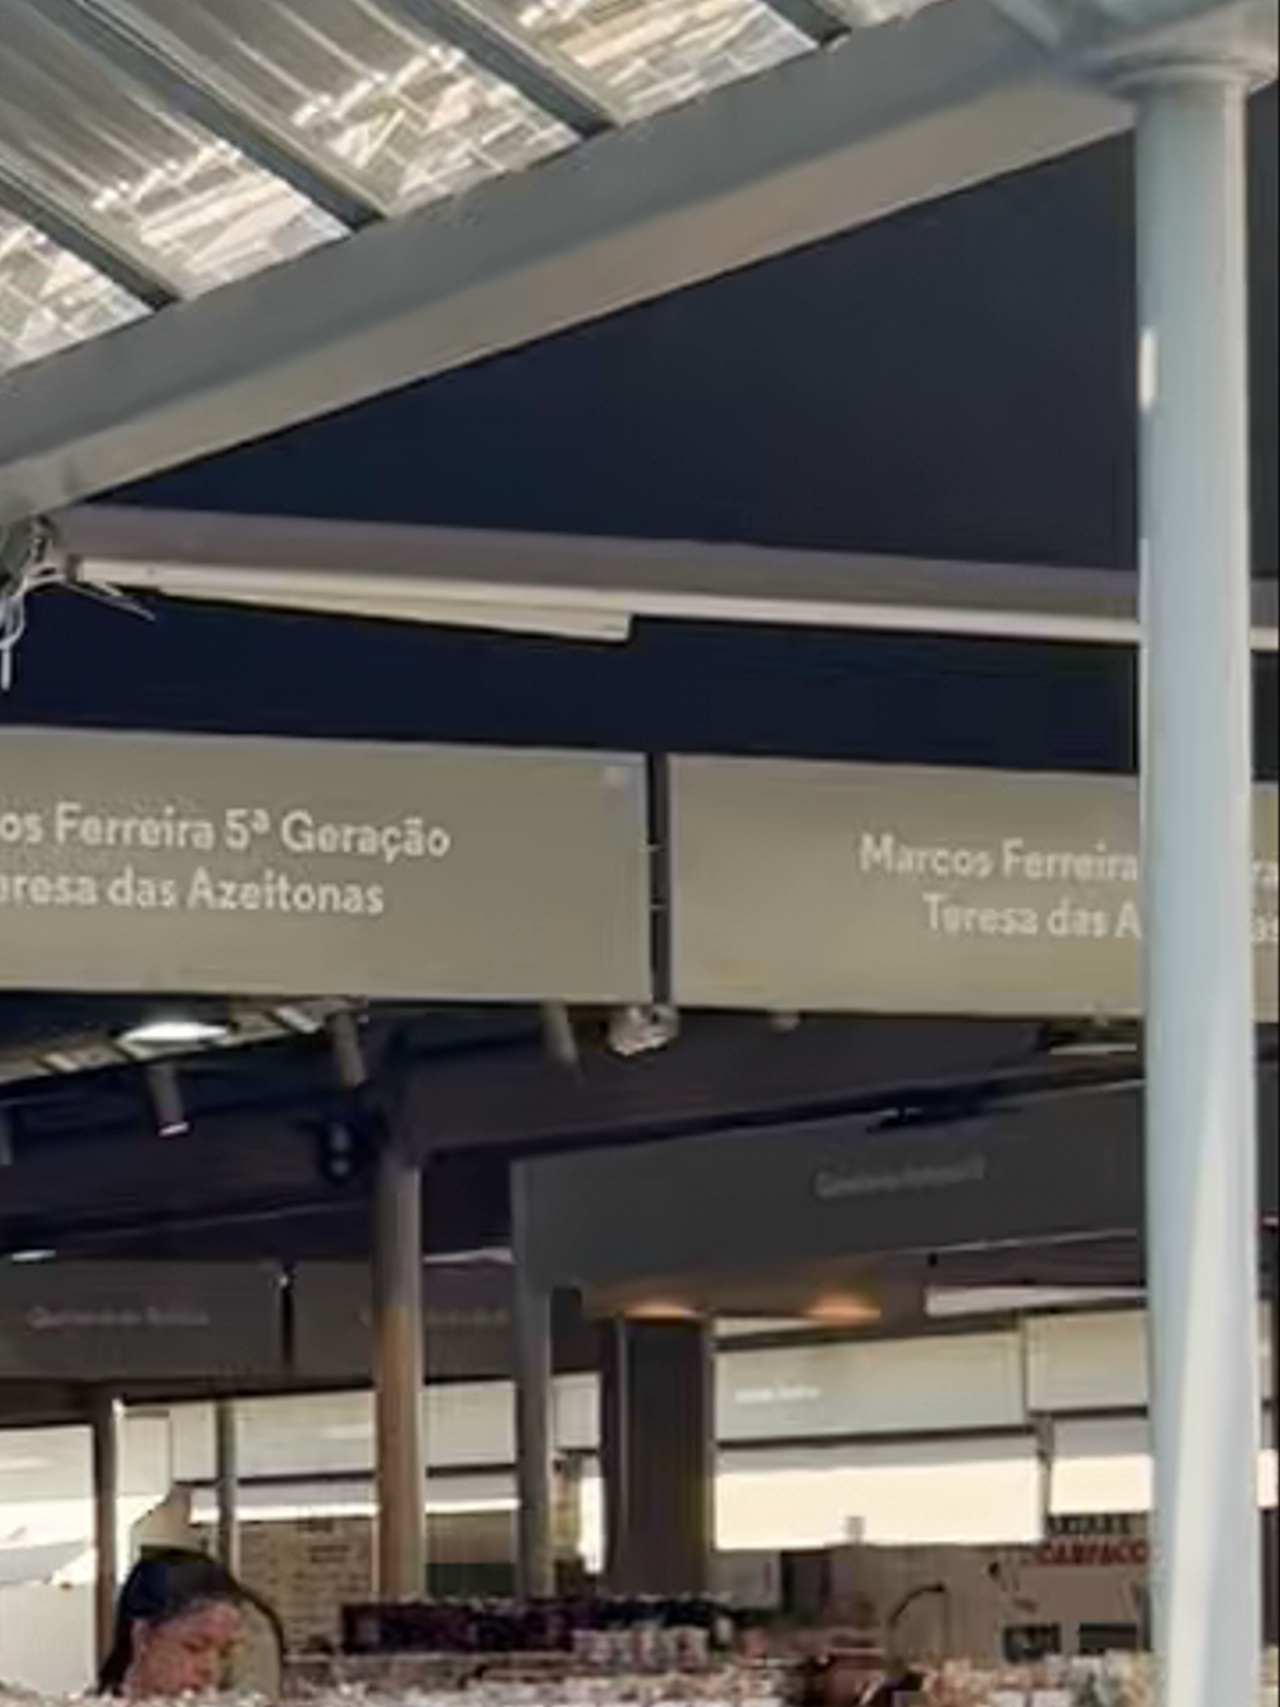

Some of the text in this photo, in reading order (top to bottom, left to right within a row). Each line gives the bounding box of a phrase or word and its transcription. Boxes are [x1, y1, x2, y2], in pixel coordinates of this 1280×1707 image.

[54, 801, 216, 850] Ferreira
[280, 810, 452, 864] Geração
[859, 833, 1139, 882] Marcos Ferreira
[107, 864, 177, 909] das
[186, 866, 385, 915] Azeitonas
[923, 892, 1039, 935] Teresa
[1046, 897, 1109, 937] das
